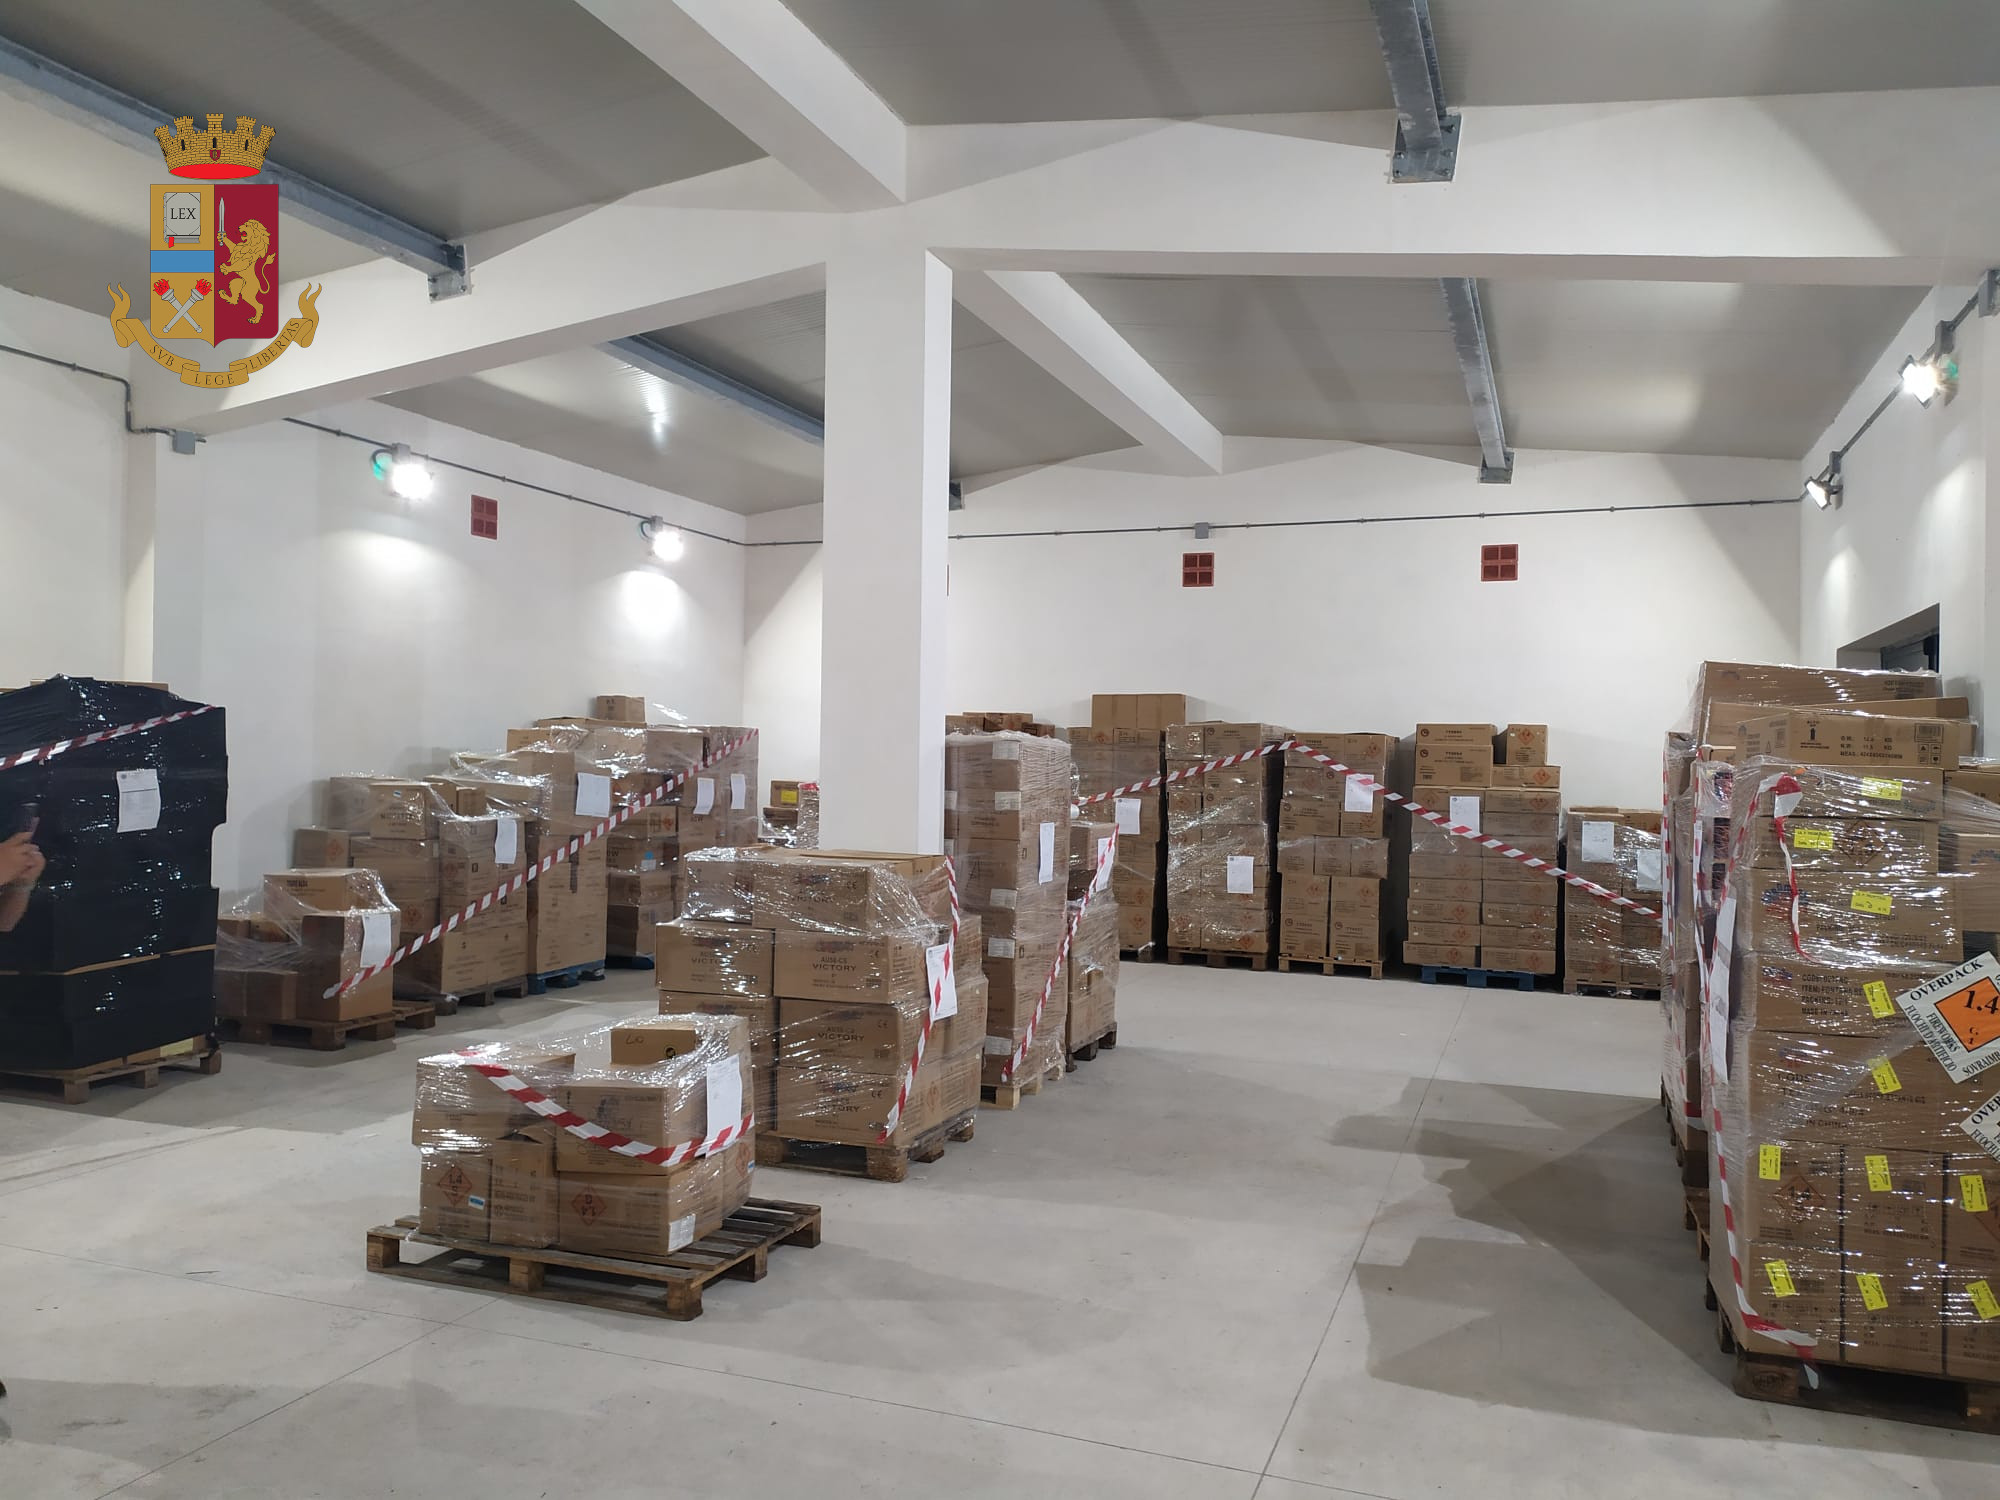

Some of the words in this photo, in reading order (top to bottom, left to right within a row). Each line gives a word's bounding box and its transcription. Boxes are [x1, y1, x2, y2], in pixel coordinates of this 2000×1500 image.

[811, 963, 857, 973] VICTORY
[1909, 959, 1984, 1001] OVERPACK
[1963, 990, 1999, 1015] 1.4
[1904, 1004, 1929, 1034] FUOCHI
[1926, 1011, 1961, 1053] FIREWORKS
[817, 1032, 865, 1042] VICTORY
